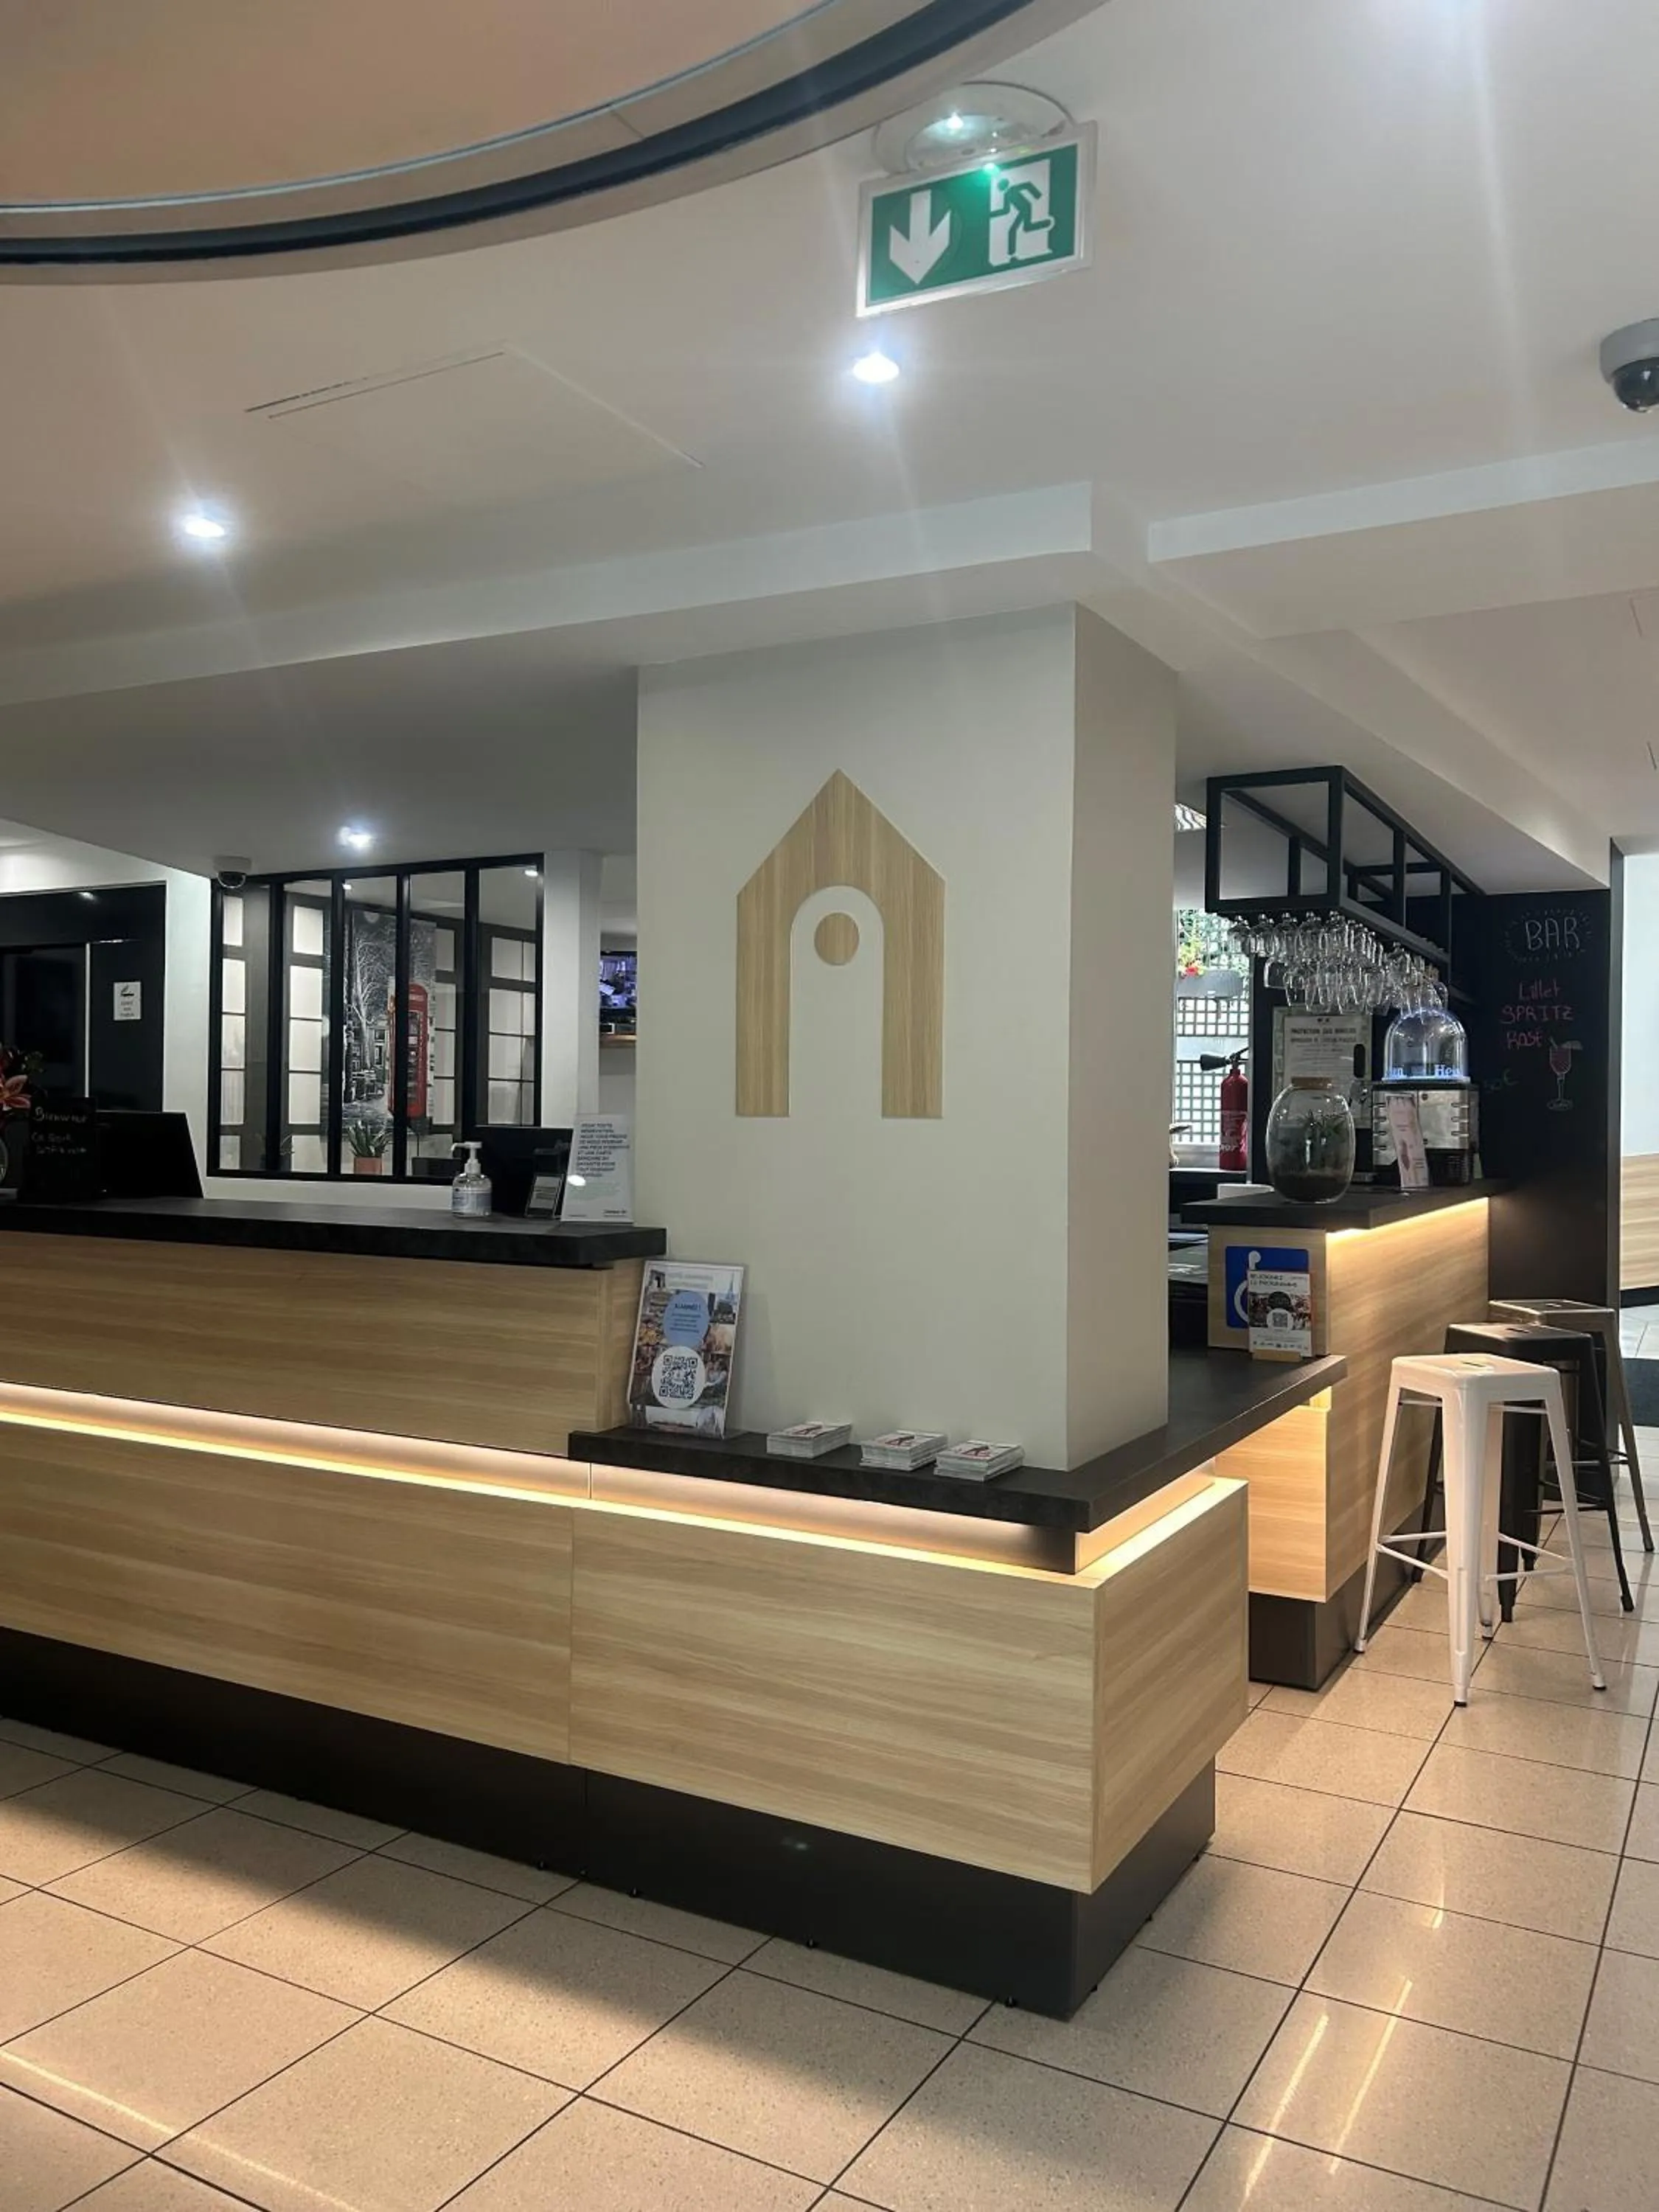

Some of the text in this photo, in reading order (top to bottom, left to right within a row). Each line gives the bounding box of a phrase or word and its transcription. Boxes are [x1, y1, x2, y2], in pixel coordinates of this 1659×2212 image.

[1525, 916, 1581, 951] BAR
[1519, 977, 1561, 1001] Lillet
[1500, 1004, 1575, 1025] SPRITZ
